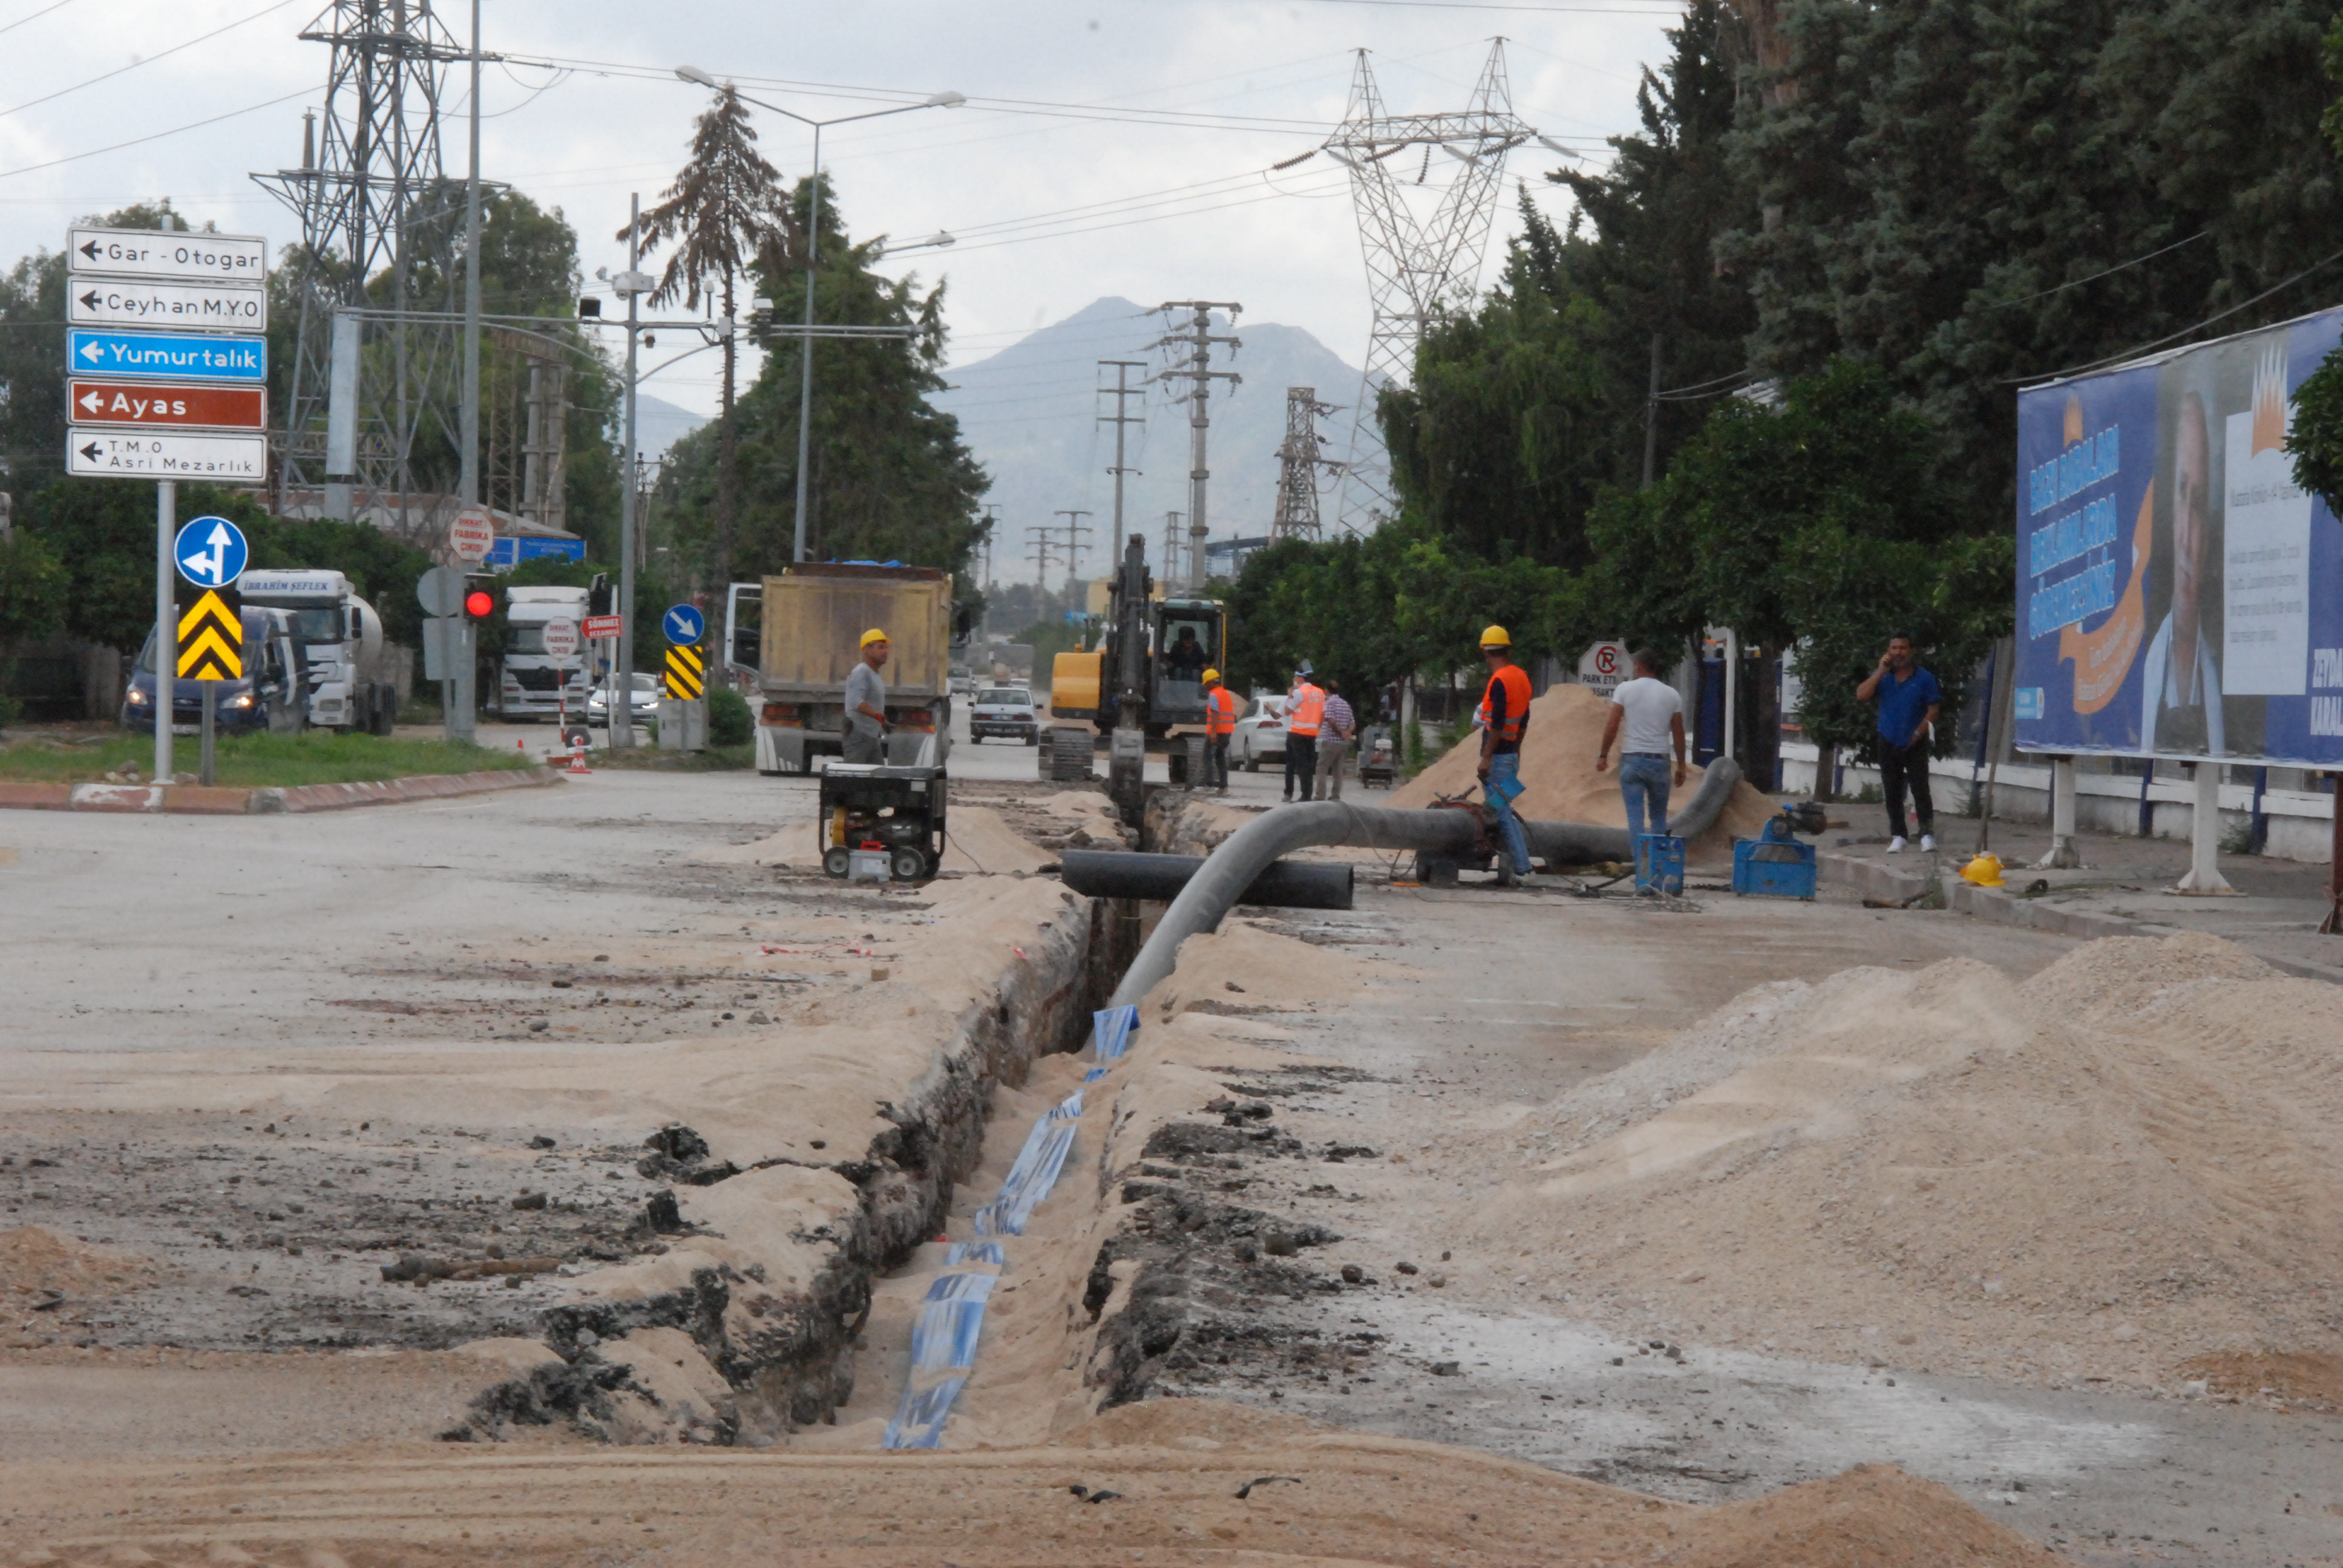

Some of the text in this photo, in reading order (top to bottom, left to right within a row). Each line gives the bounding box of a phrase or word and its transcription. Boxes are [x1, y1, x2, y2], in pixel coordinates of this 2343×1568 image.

[108, 244, 149, 261] Gar
[175, 247, 258, 270] Otogar
[108, 294, 258, 317] Ceyhan M.Y.O
[110, 342, 257, 368] Yumurtalık
[110, 392, 186, 419] Ayas
[110, 456, 252, 472] Asri Mezarlık
[244, 580, 328, 592] İBRAHİM ŞEFLEK
[1582, 674, 1601, 684] PARK
